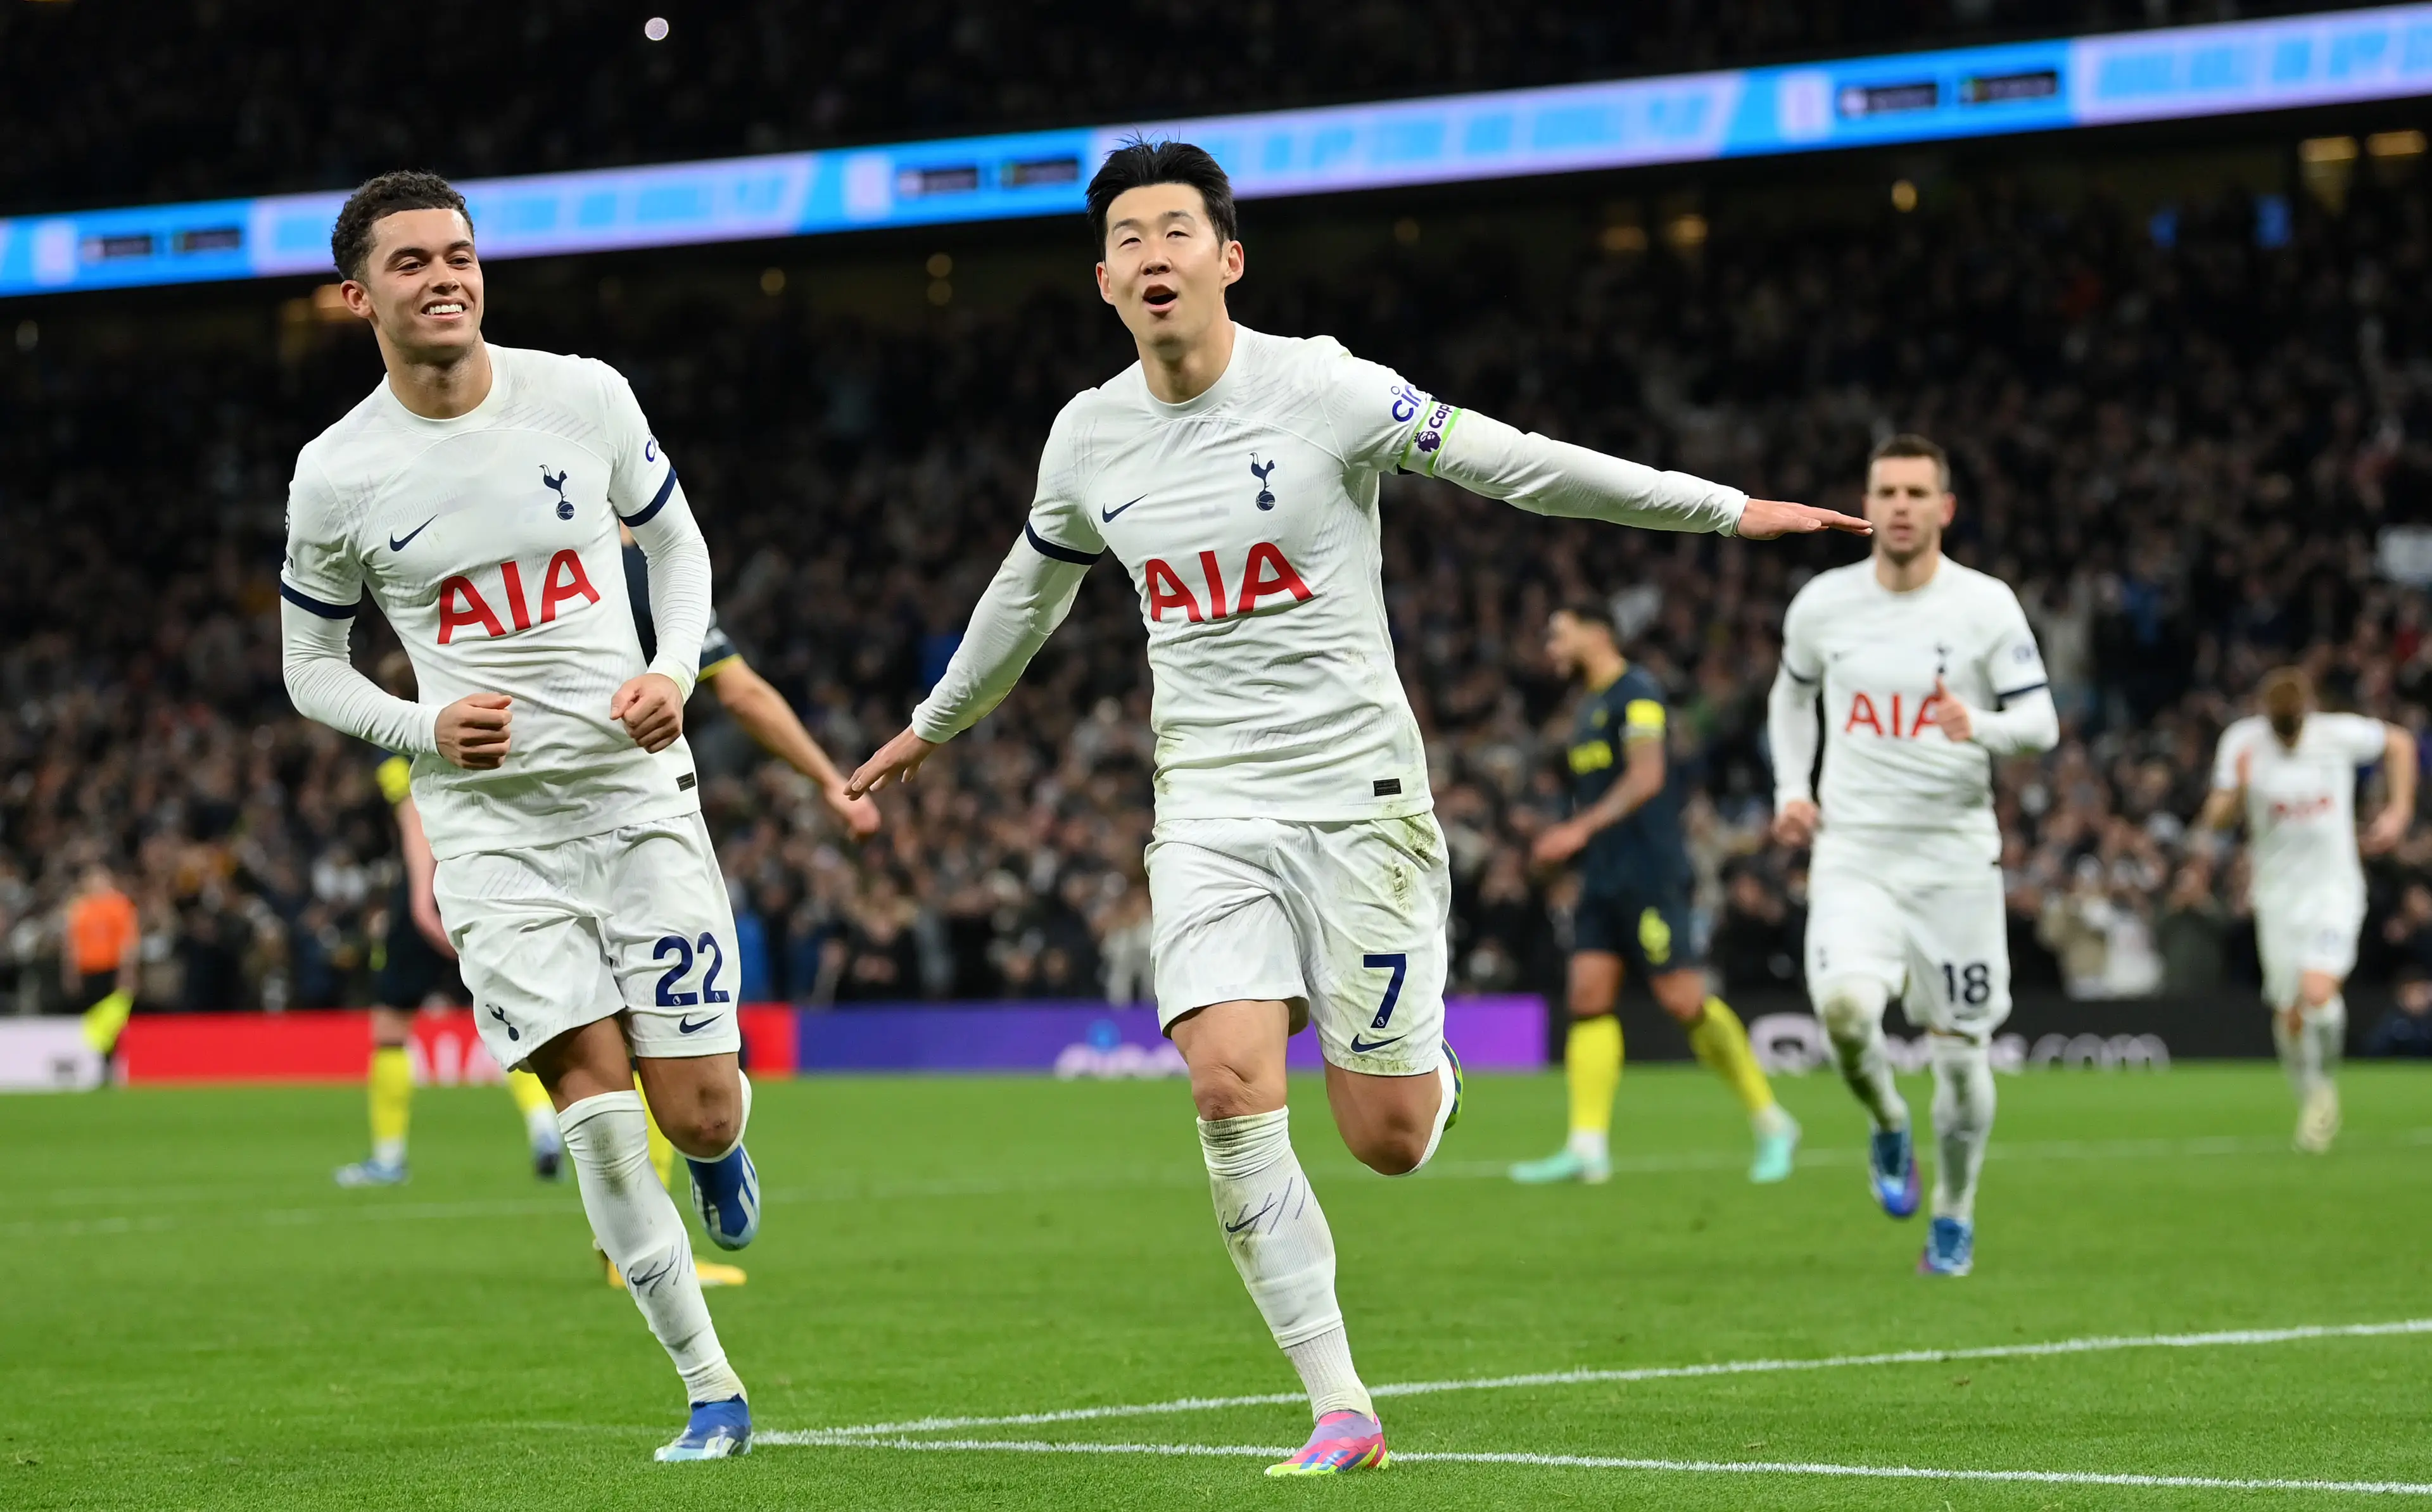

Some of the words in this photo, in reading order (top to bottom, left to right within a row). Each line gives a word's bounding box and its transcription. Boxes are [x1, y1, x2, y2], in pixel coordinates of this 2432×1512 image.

[436, 548, 600, 645] AIA
[1145, 542, 1314, 622] AIA
[652, 931, 730, 1007] 22
[1363, 953, 1407, 1029] 7
[1942, 962, 1991, 1006] 18
